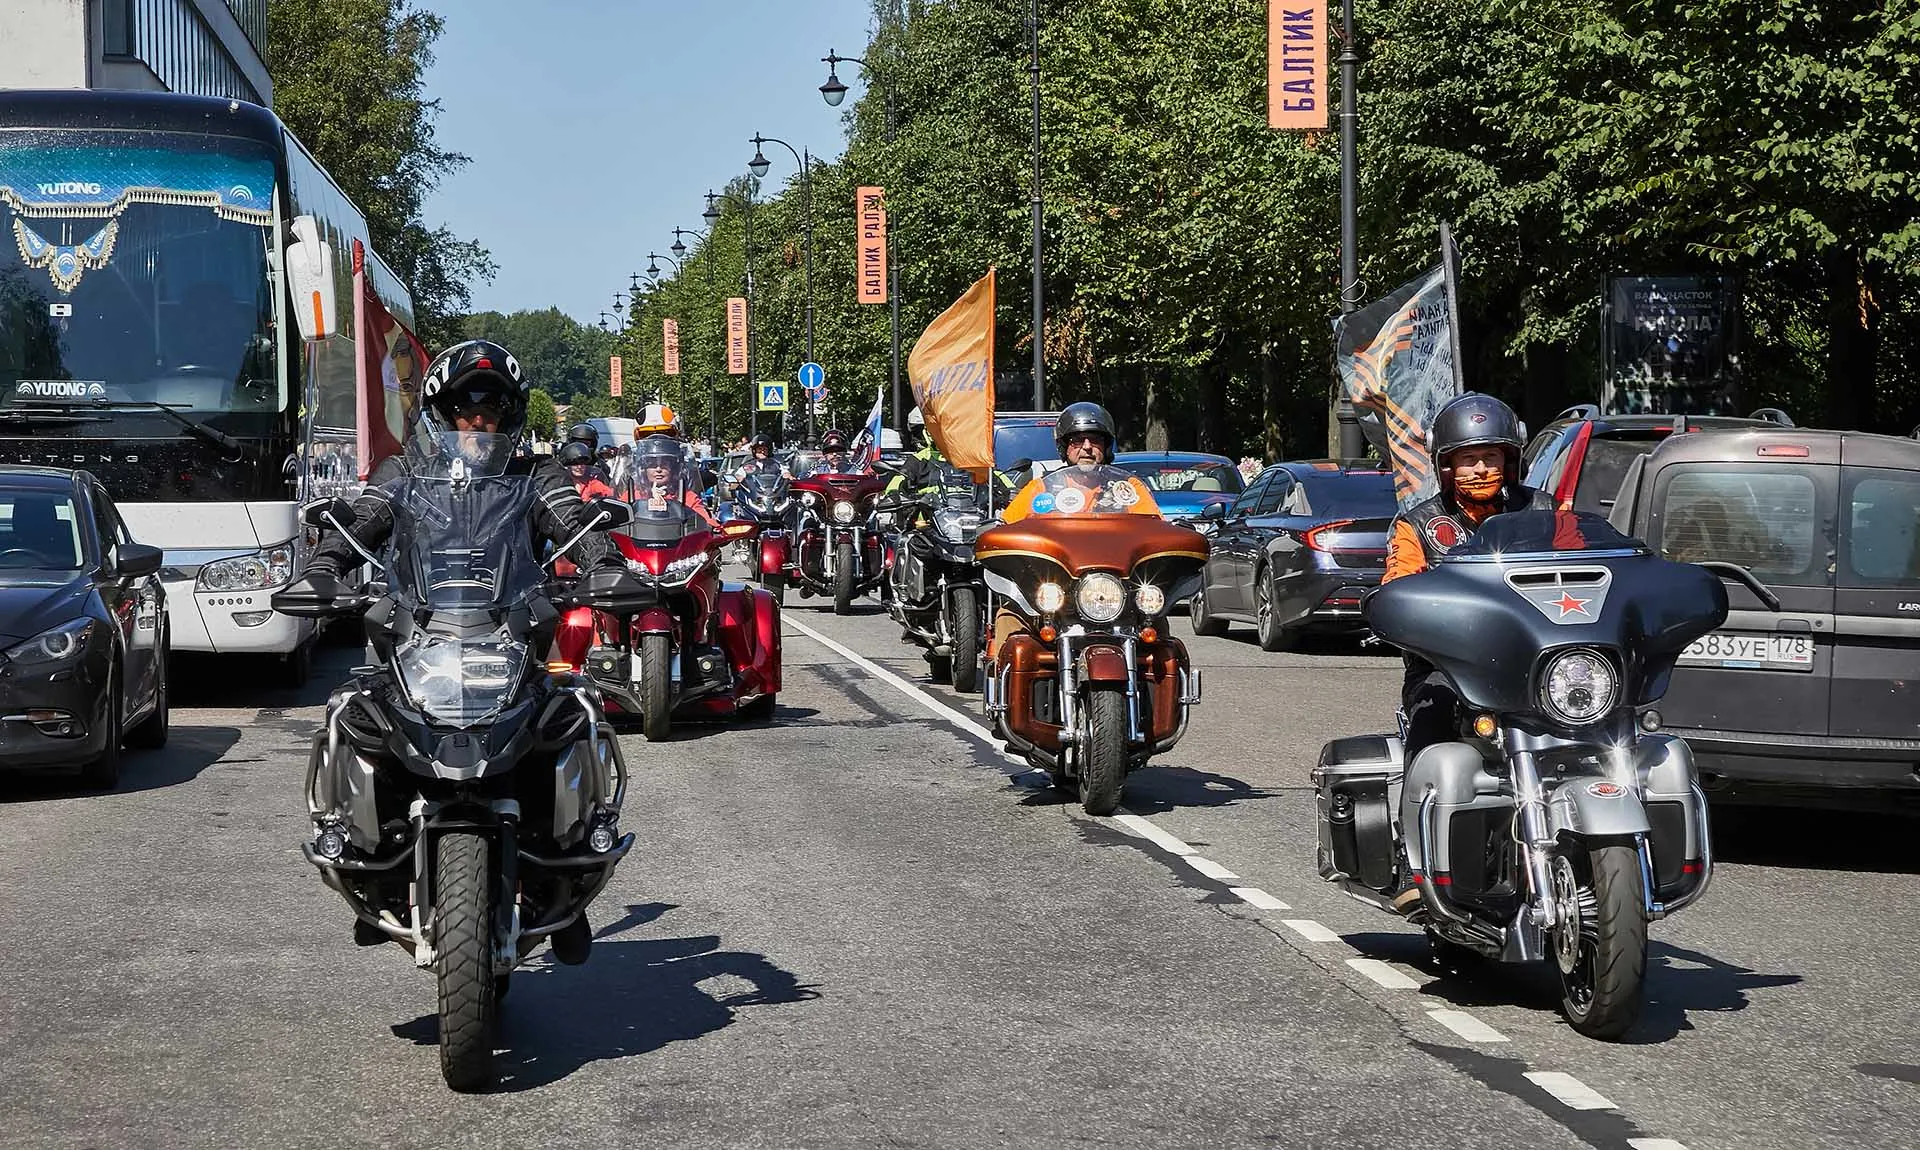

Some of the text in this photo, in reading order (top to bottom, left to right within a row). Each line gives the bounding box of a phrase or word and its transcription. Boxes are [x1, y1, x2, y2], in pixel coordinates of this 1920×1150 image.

[1283, 8, 1315, 111] БАЛТИК
[37, 182, 101, 194] YUTONG
[865, 247, 881, 295] БАЛТИК
[732, 302, 744, 369] БАЛТИК РАЛЛИ
[33, 382, 87, 396] YUTONG
[1682, 636, 1806, 658] 583УЕ 178
